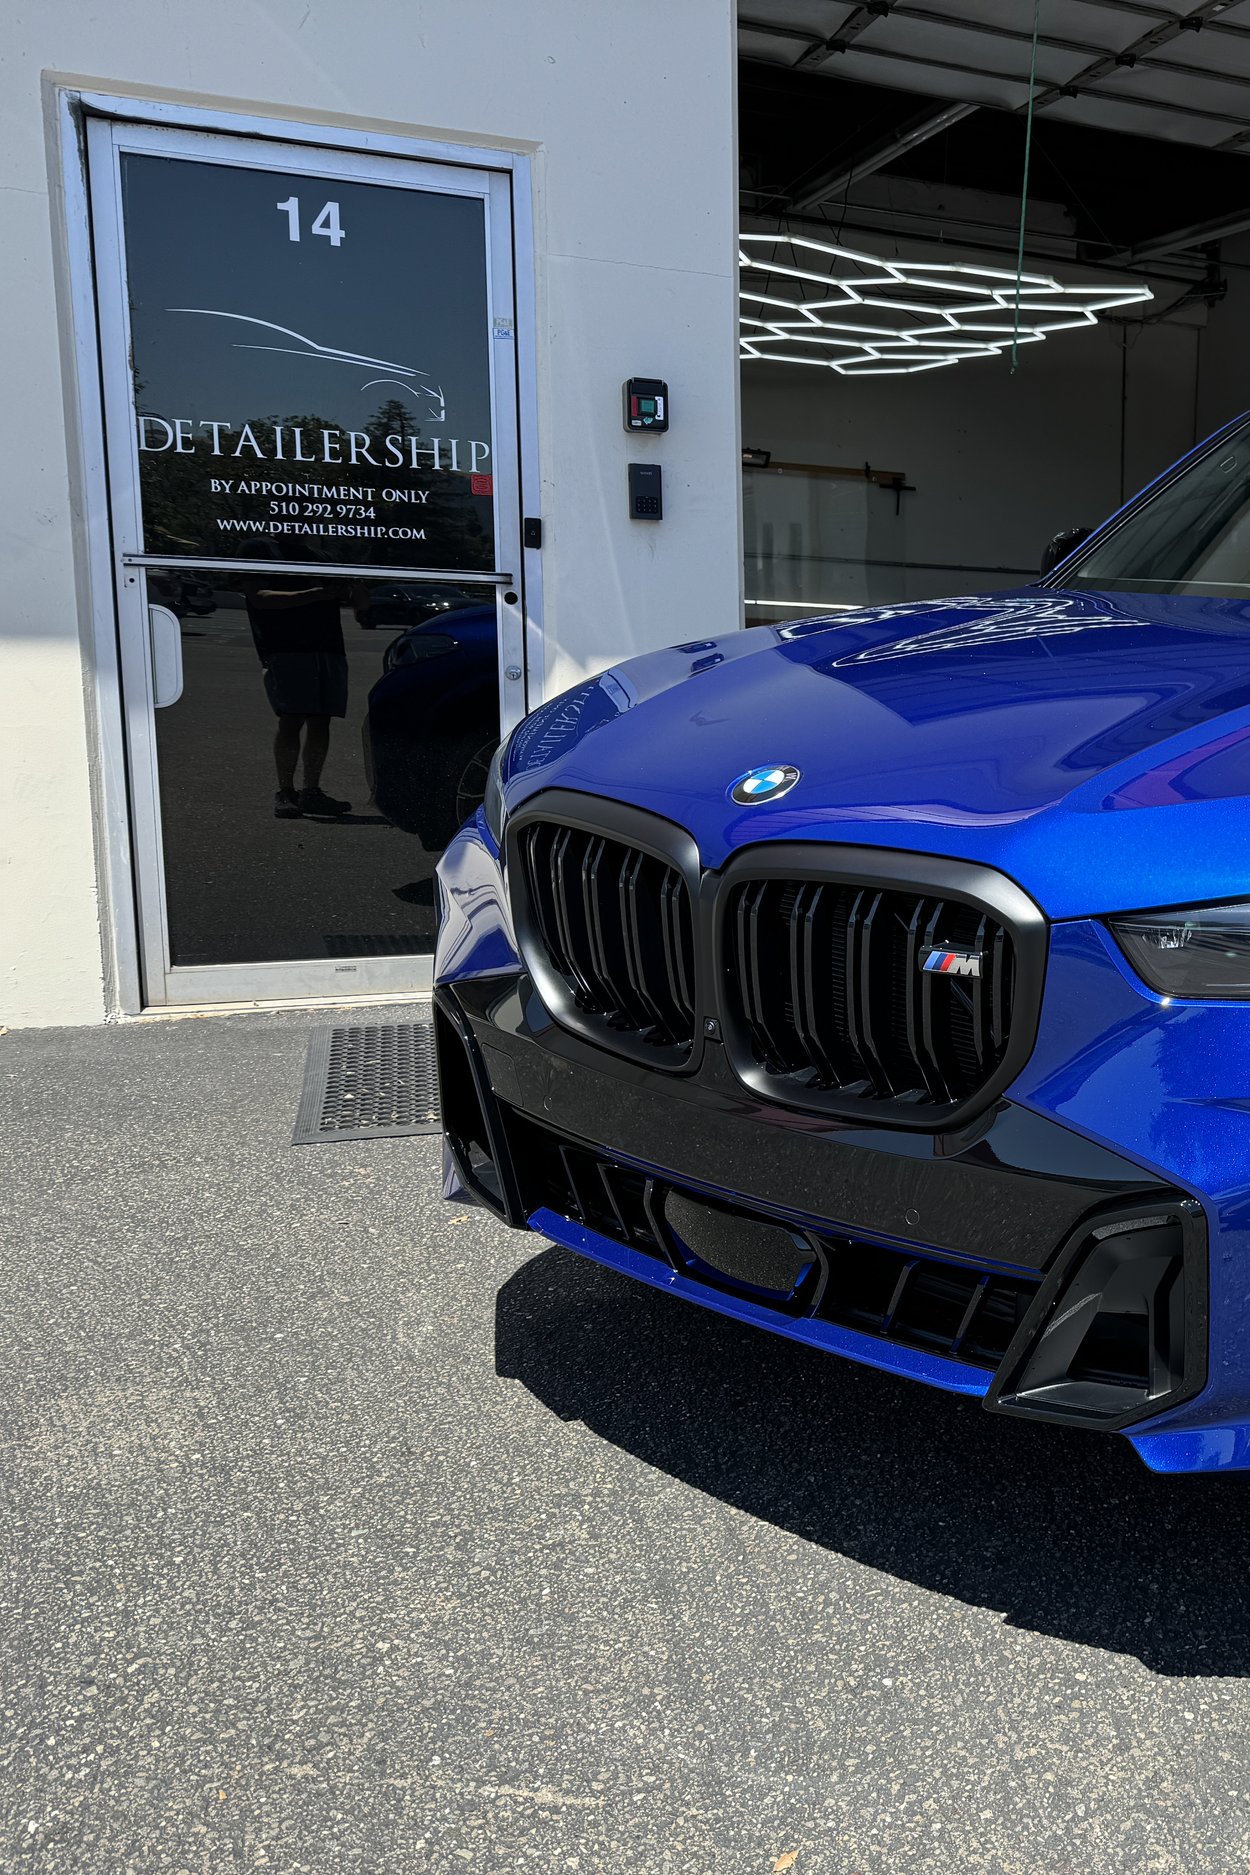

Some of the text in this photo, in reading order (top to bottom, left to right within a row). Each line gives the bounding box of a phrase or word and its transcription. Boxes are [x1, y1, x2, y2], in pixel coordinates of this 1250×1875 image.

[277, 197, 346, 246] 14
[138, 416, 490, 474] DETAILERSHIP
[210, 479, 430, 504] BY APPOINTMENT ONLY
[269, 501, 376, 520] 510 292 9734
[216, 519, 427, 540] WWW.DETAILERSHIP.COM
